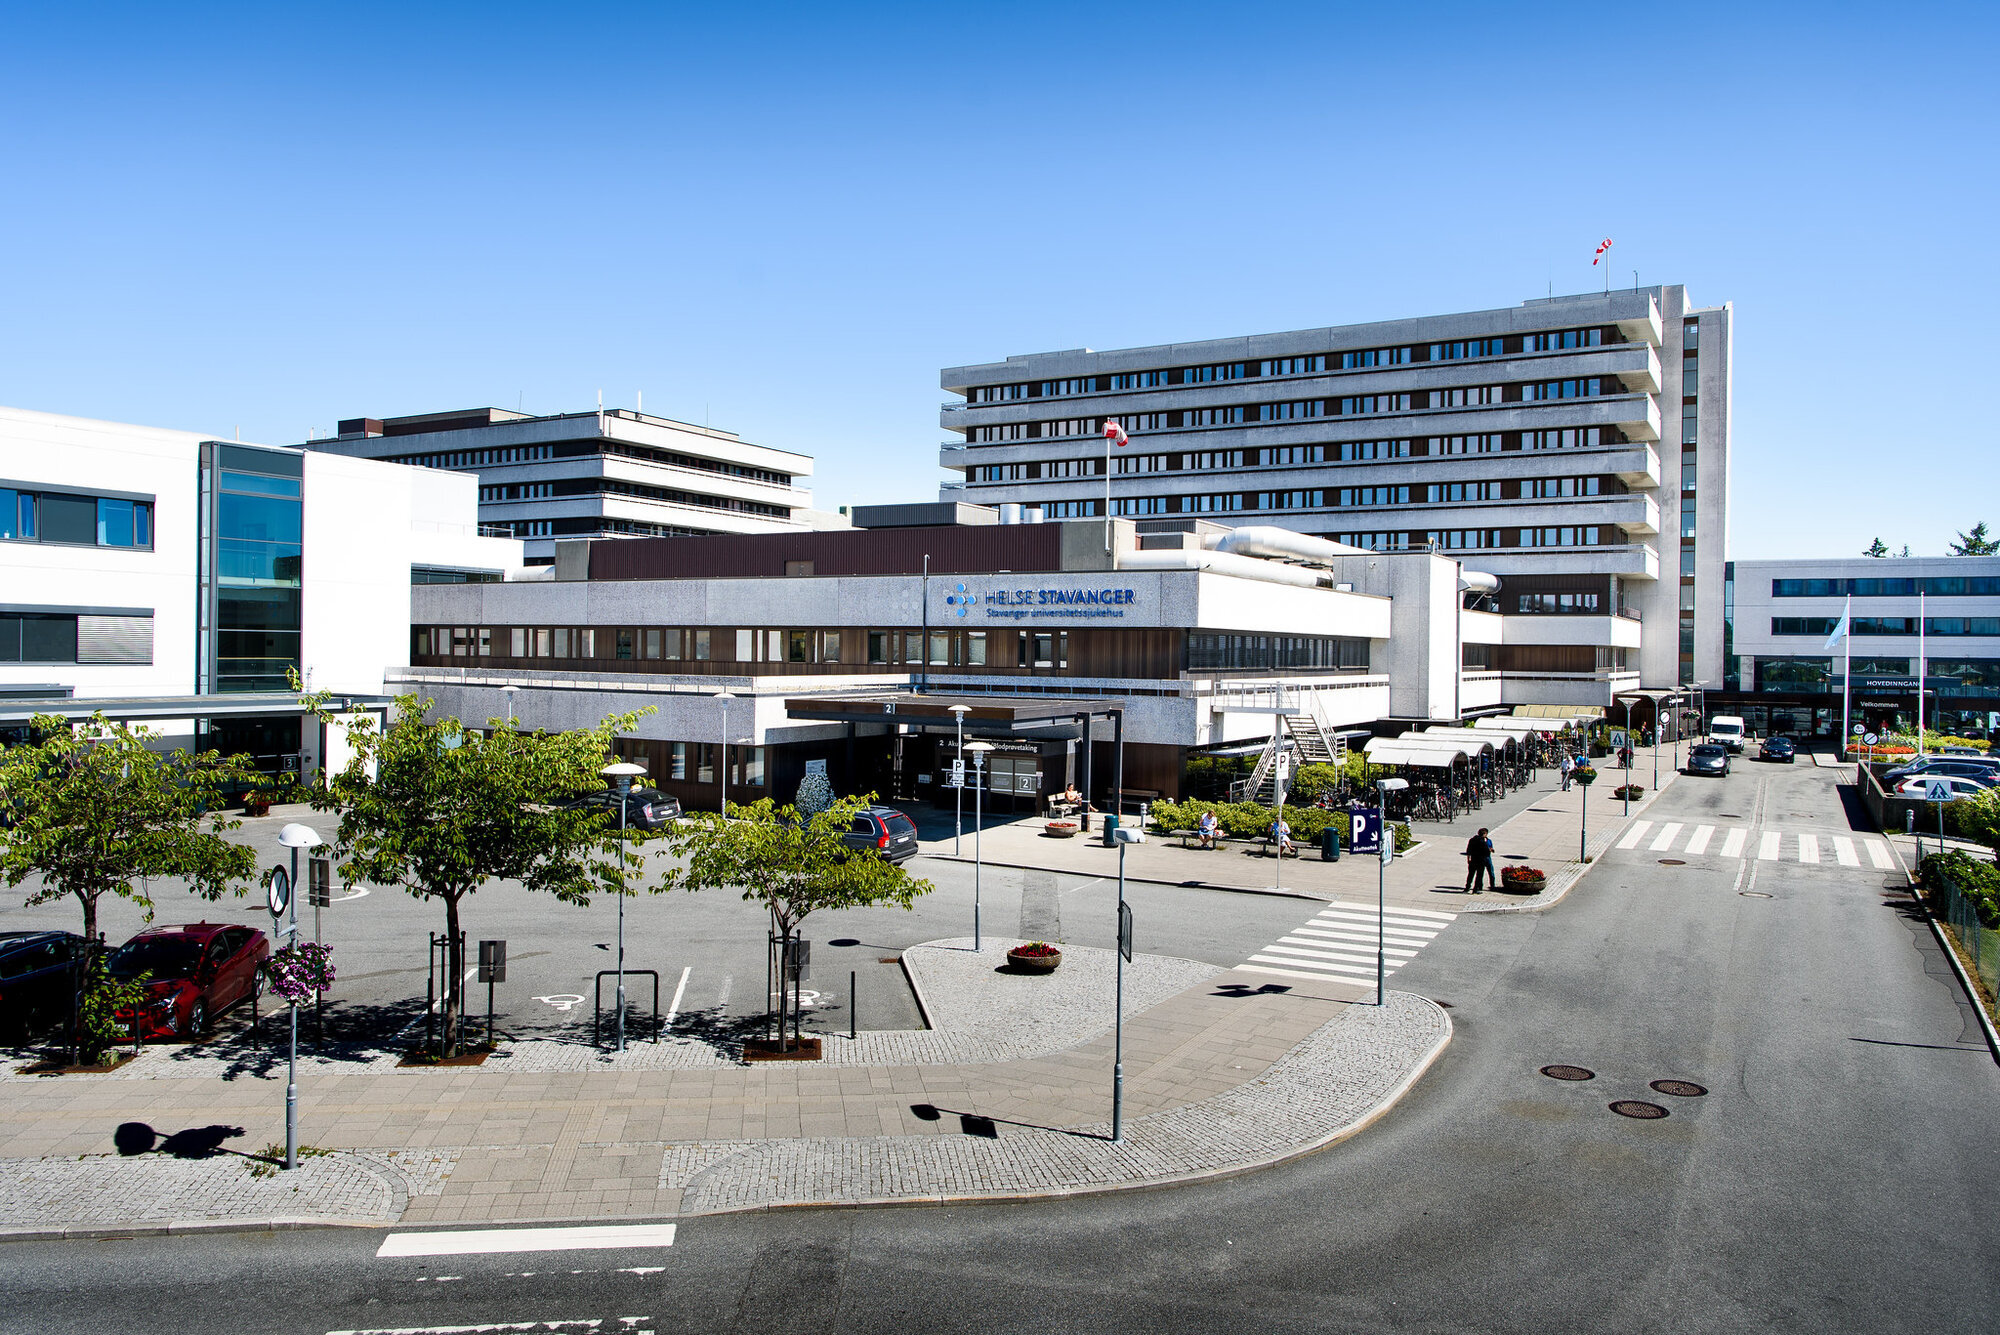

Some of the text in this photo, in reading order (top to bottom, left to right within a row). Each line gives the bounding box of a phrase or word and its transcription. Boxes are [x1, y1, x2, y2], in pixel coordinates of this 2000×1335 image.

[985, 588, 1136, 605] HELSE STAVANGER
[986, 607, 1124, 620] Stavanger universitetssjukehus
[346, 699, 352, 707] 3
[885, 704, 892, 713] 2
[287, 759, 293, 768] 3
[955, 762, 962, 772] P
[1280, 755, 1286, 769] P
[1022, 778, 1029, 788] 2
[1353, 815, 1366, 843] P
